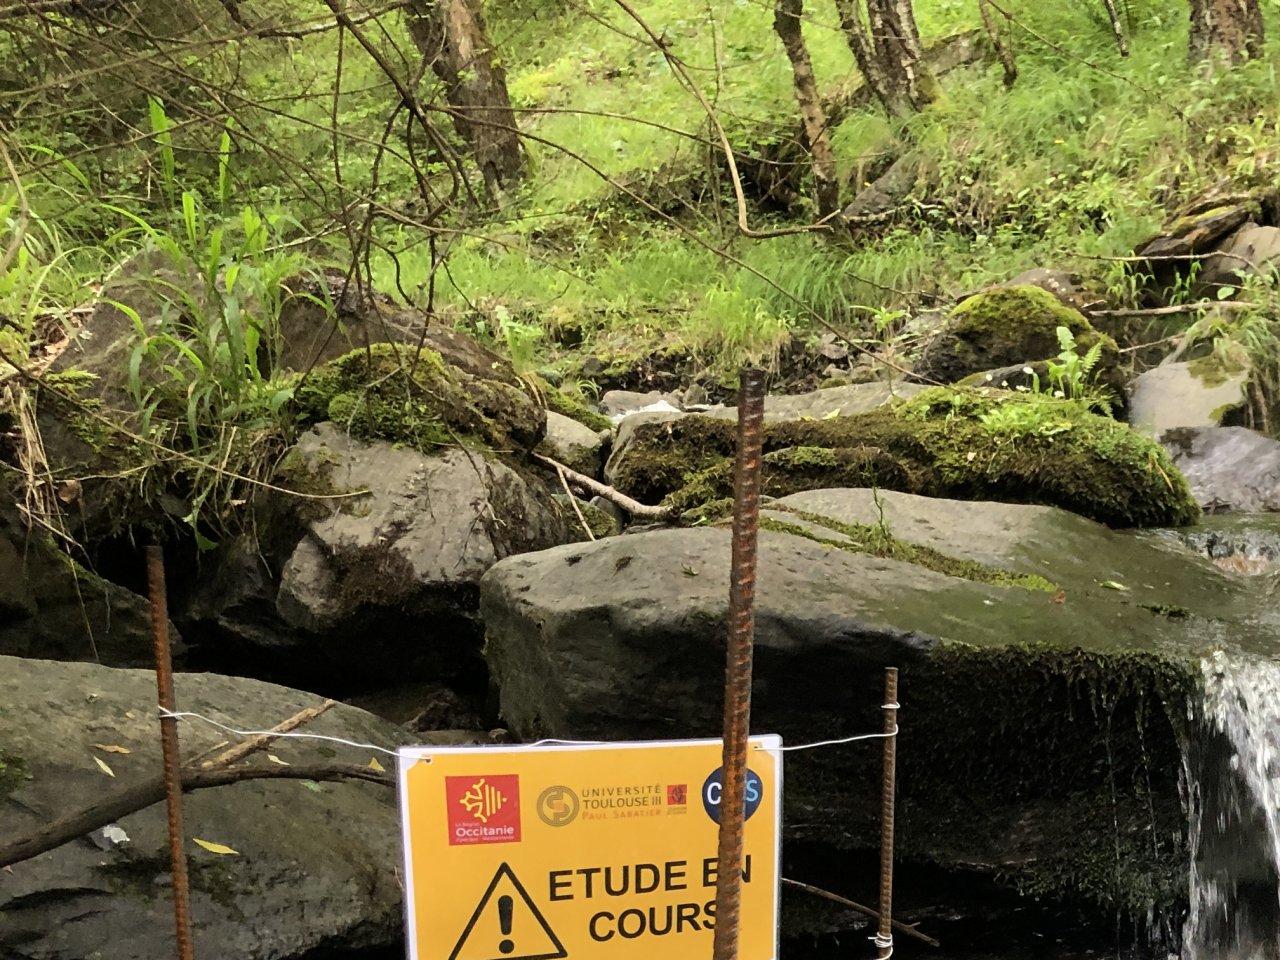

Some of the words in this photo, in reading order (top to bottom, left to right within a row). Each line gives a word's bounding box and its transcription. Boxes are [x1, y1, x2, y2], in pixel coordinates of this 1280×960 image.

[581, 783, 662, 798] UNIVERSITÉ
[706, 779, 759, 805] CS
[583, 797, 649, 810] TOULOUSE
[455, 825, 515, 838] Occitanie
[549, 860, 688, 902] ETUDE
